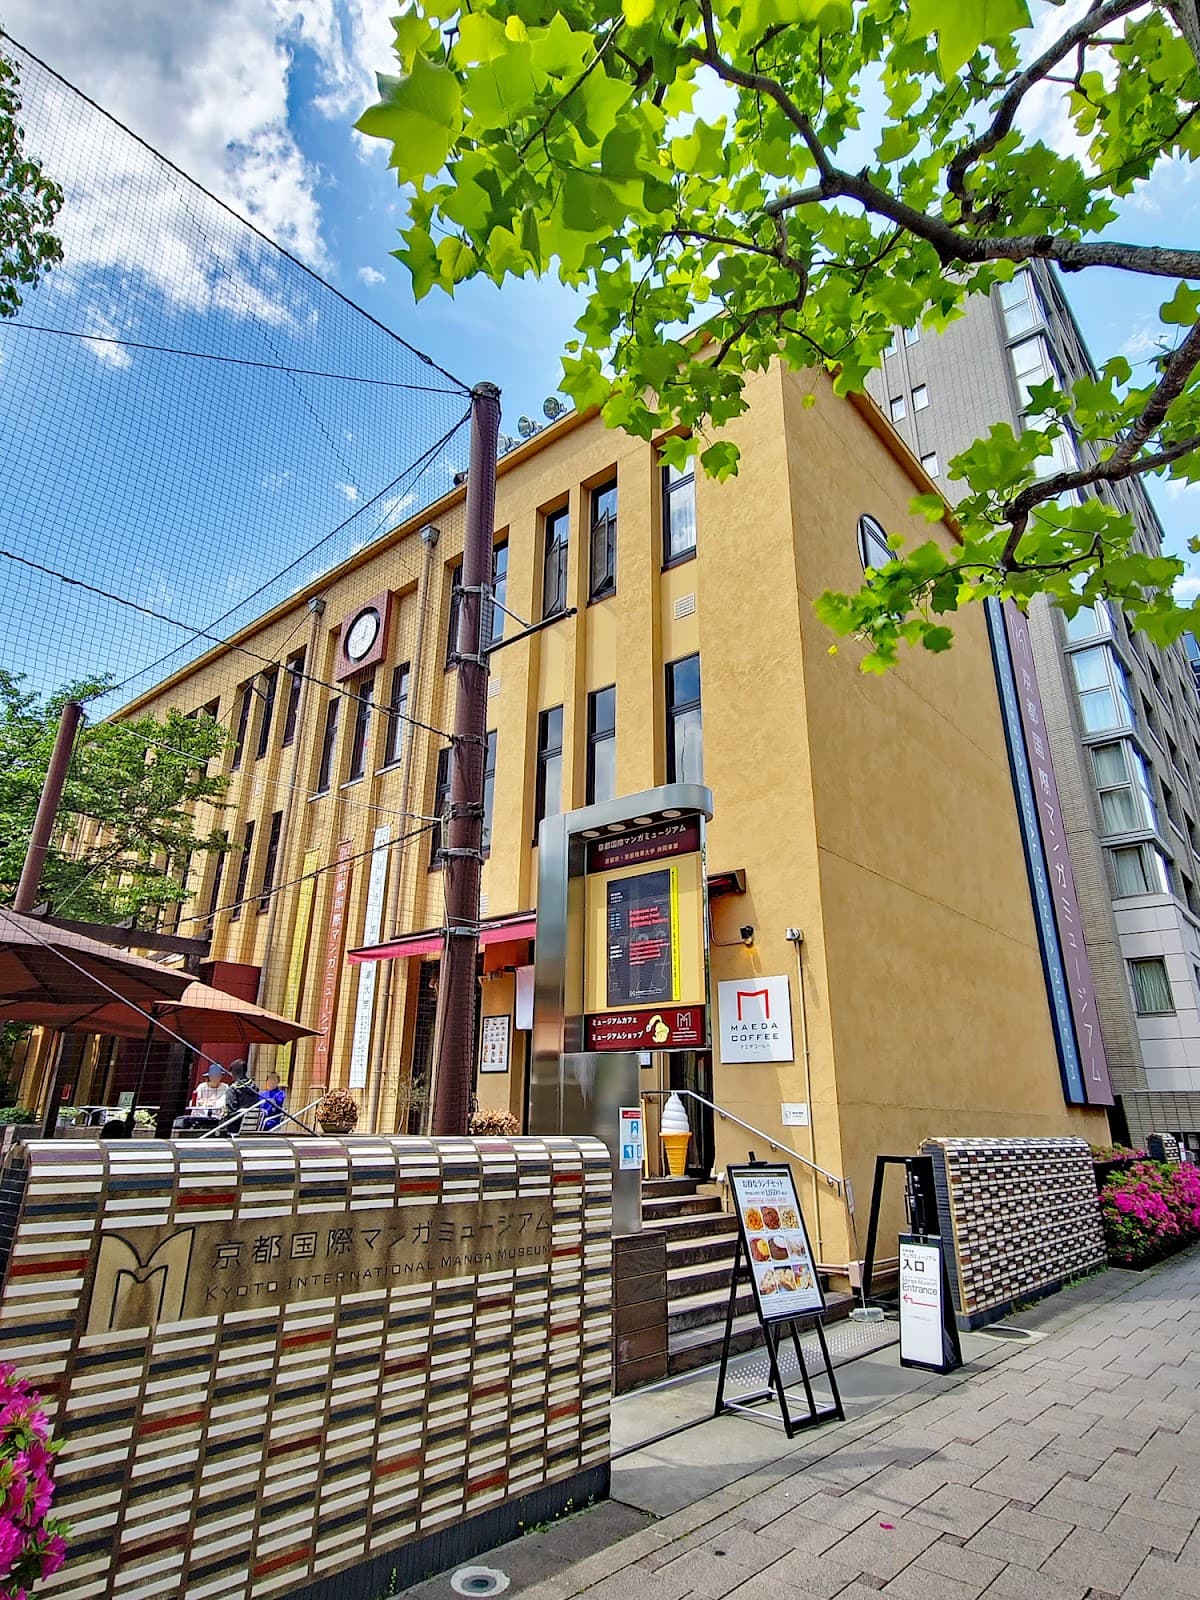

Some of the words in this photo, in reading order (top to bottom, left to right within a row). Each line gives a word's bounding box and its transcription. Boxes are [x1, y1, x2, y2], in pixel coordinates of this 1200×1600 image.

[598, 825, 687, 851] 京都国際マンガミュージアム
[591, 1016, 638, 1027] ミュージアムカフェ
[730, 1021, 778, 1032] MAEDA
[591, 1030, 644, 1042] ミュージアムショップ
[731, 1032, 779, 1042] COFFEE
[212, 1211, 551, 1270] 京都国際マンガミュージアム
[902, 1258, 925, 1273] 入口
[205, 1280, 278, 1302] KYOTO
[288, 1261, 434, 1291] INTERNATIONAL
[441, 1250, 494, 1269] MANGA
[498, 1244, 551, 1260] MUSEUM
[902, 1282, 938, 1296] Entrance
